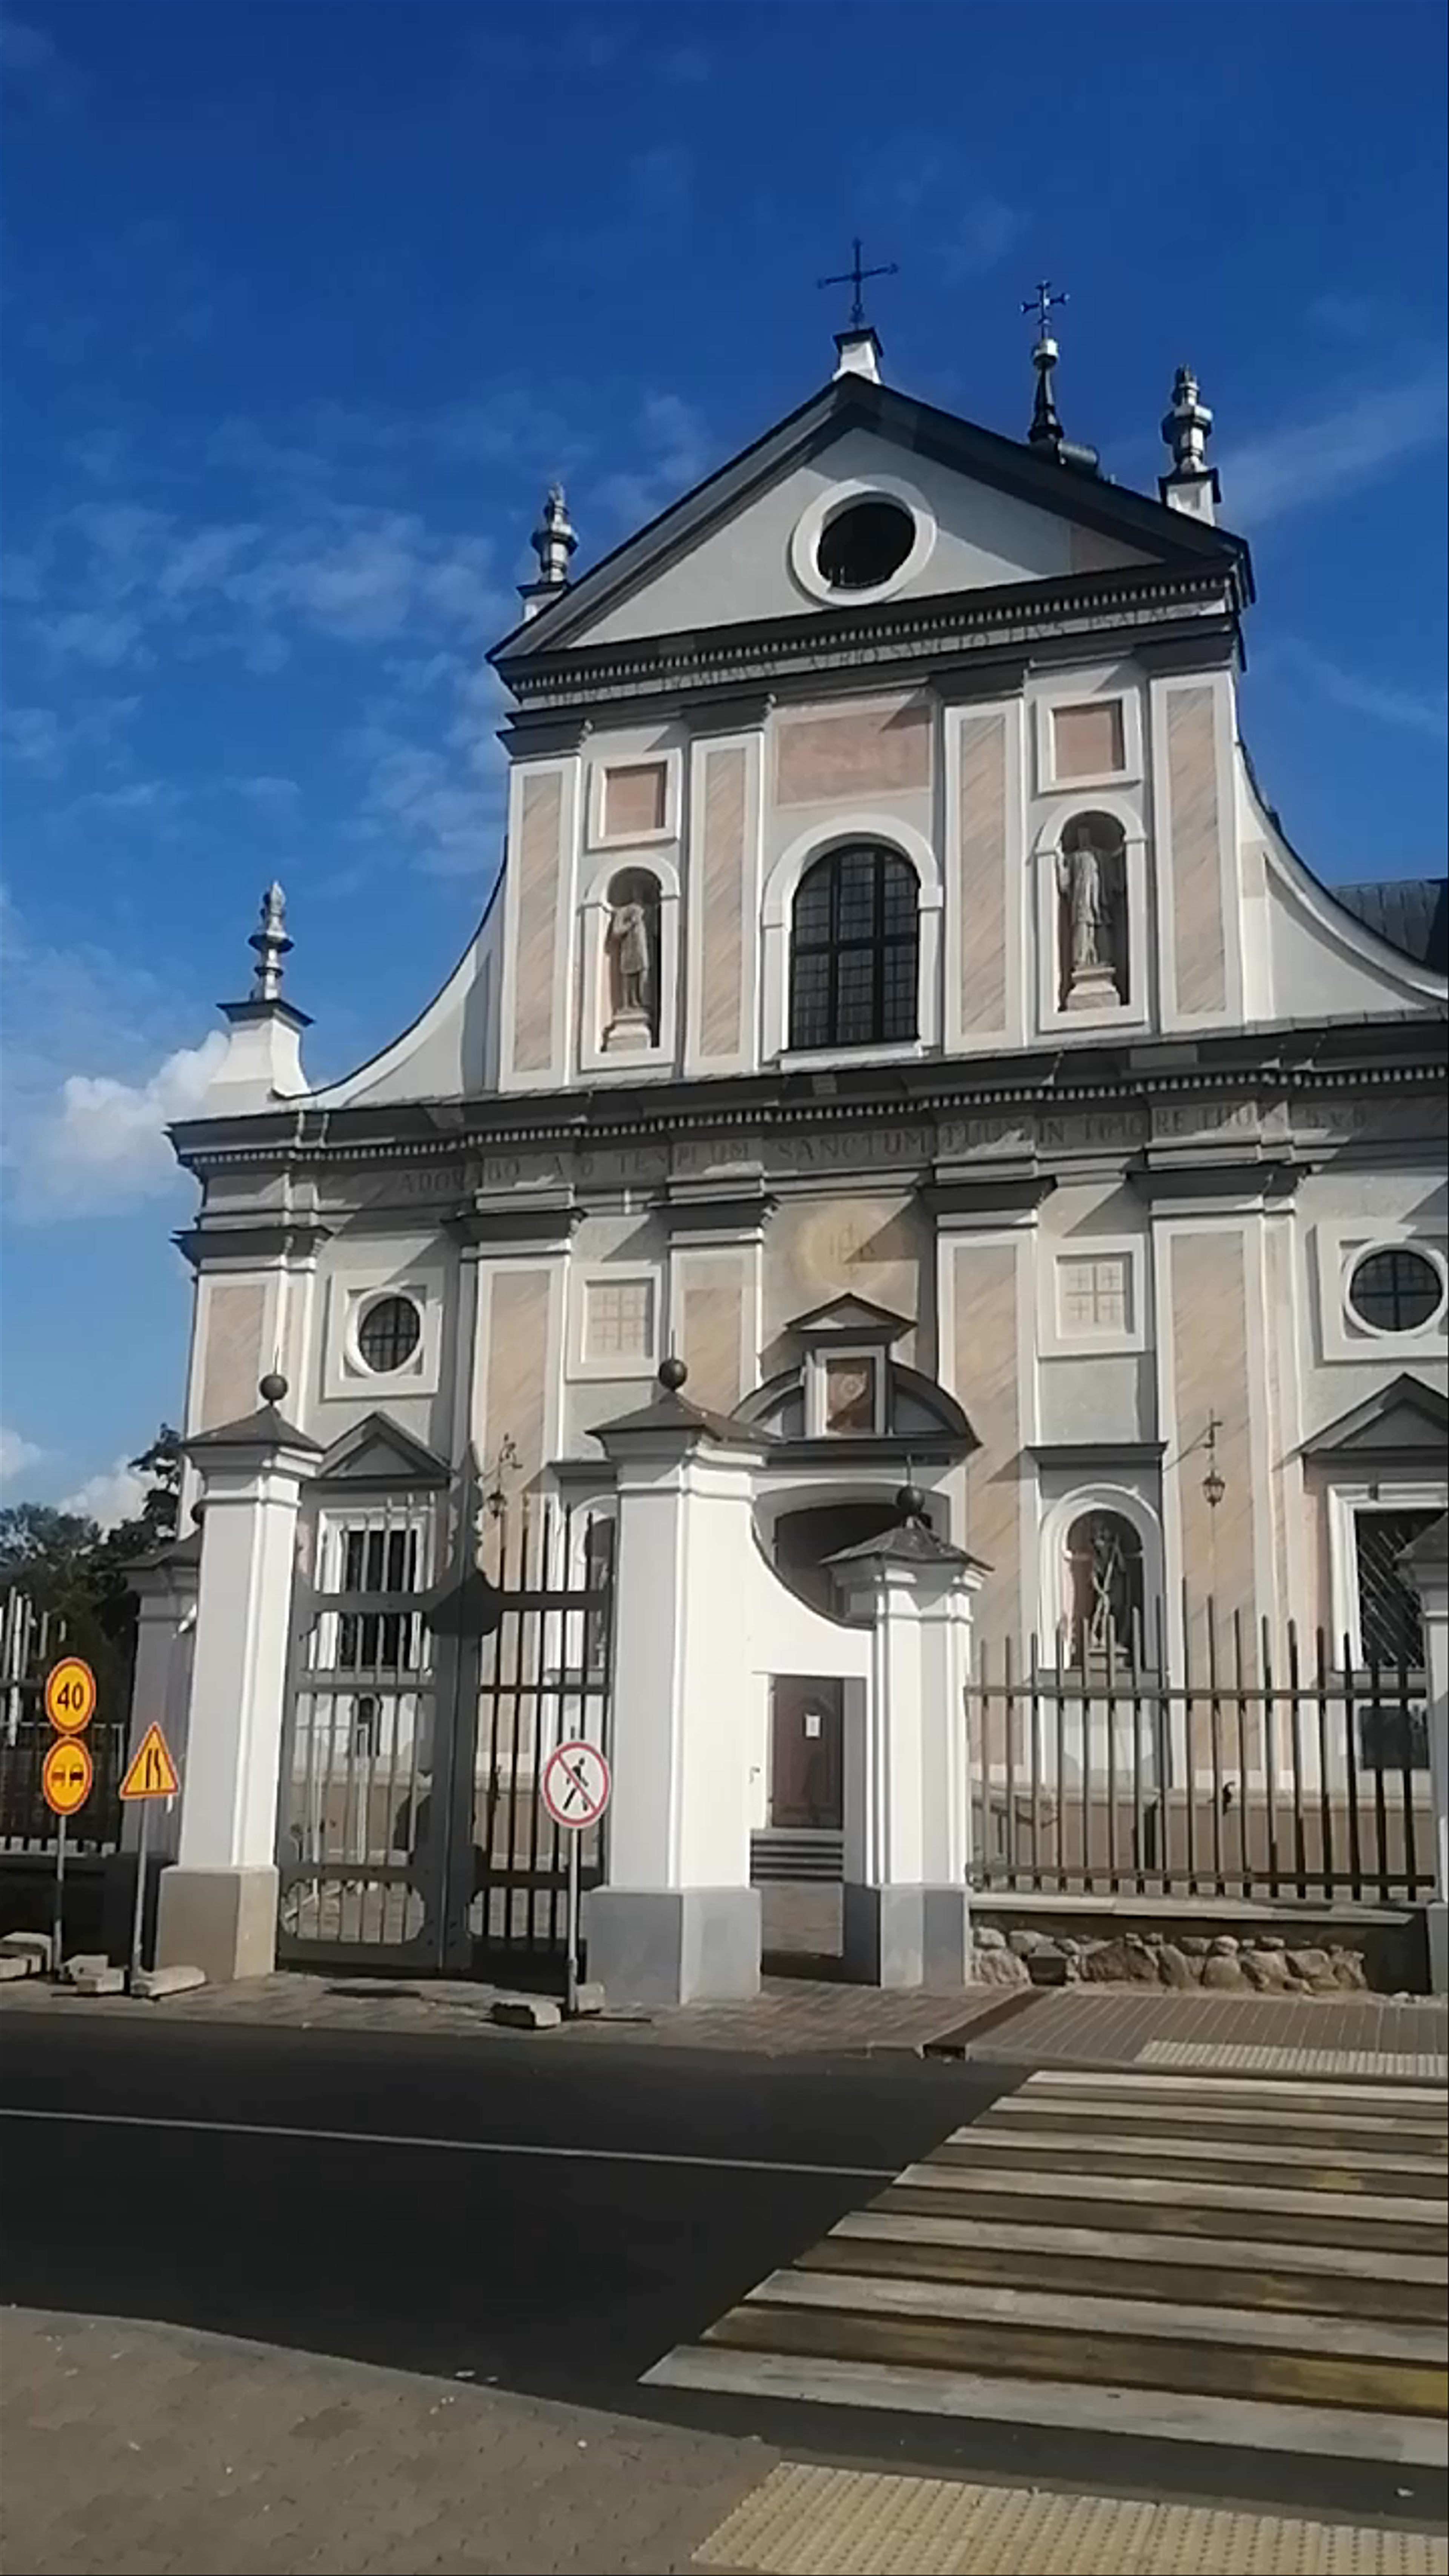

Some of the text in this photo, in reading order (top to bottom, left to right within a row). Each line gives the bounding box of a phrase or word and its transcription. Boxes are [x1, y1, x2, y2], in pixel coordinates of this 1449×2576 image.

[775, 1131, 925, 1163] SANCTUM
[1038, 1121, 1063, 1143] IN
[57, 1682, 84, 1711] 40
